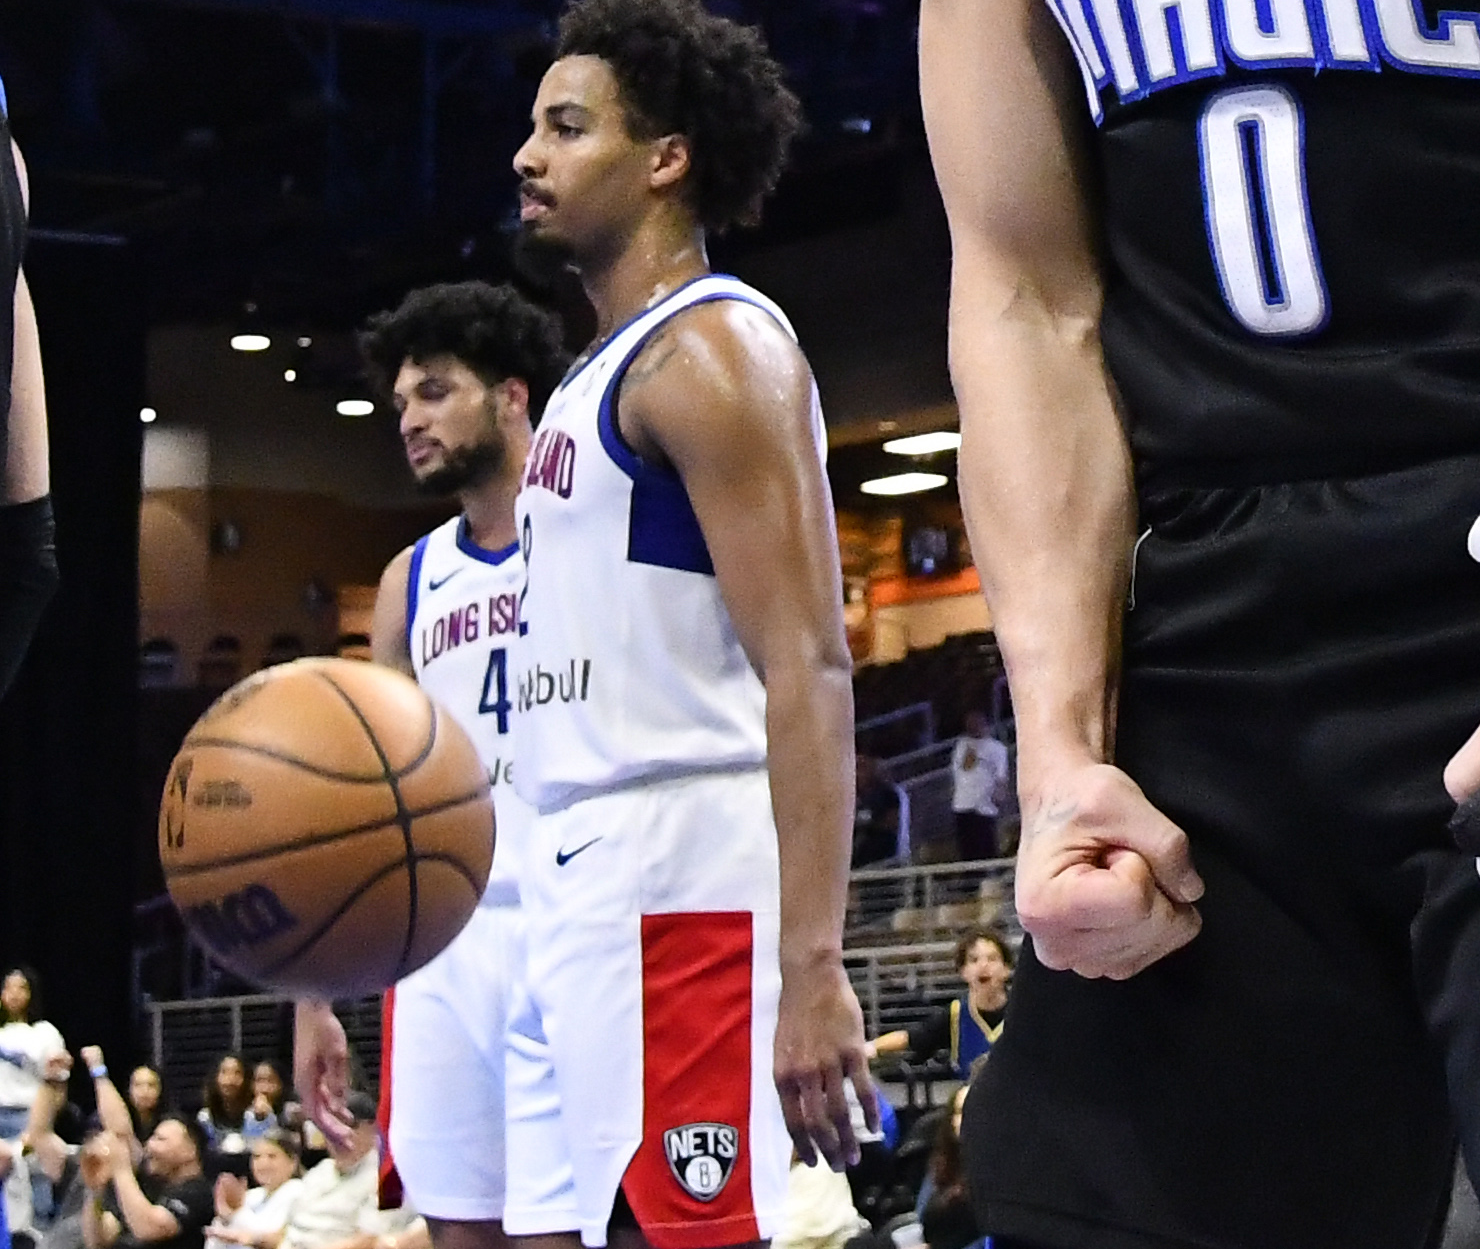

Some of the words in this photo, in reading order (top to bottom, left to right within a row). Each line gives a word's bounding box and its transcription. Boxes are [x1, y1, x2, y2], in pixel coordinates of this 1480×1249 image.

[1196, 82, 1332, 338] 0
[421, 603, 479, 668] LONG
[477, 647, 512, 735] 4
[670, 1126, 736, 1162] NETS
